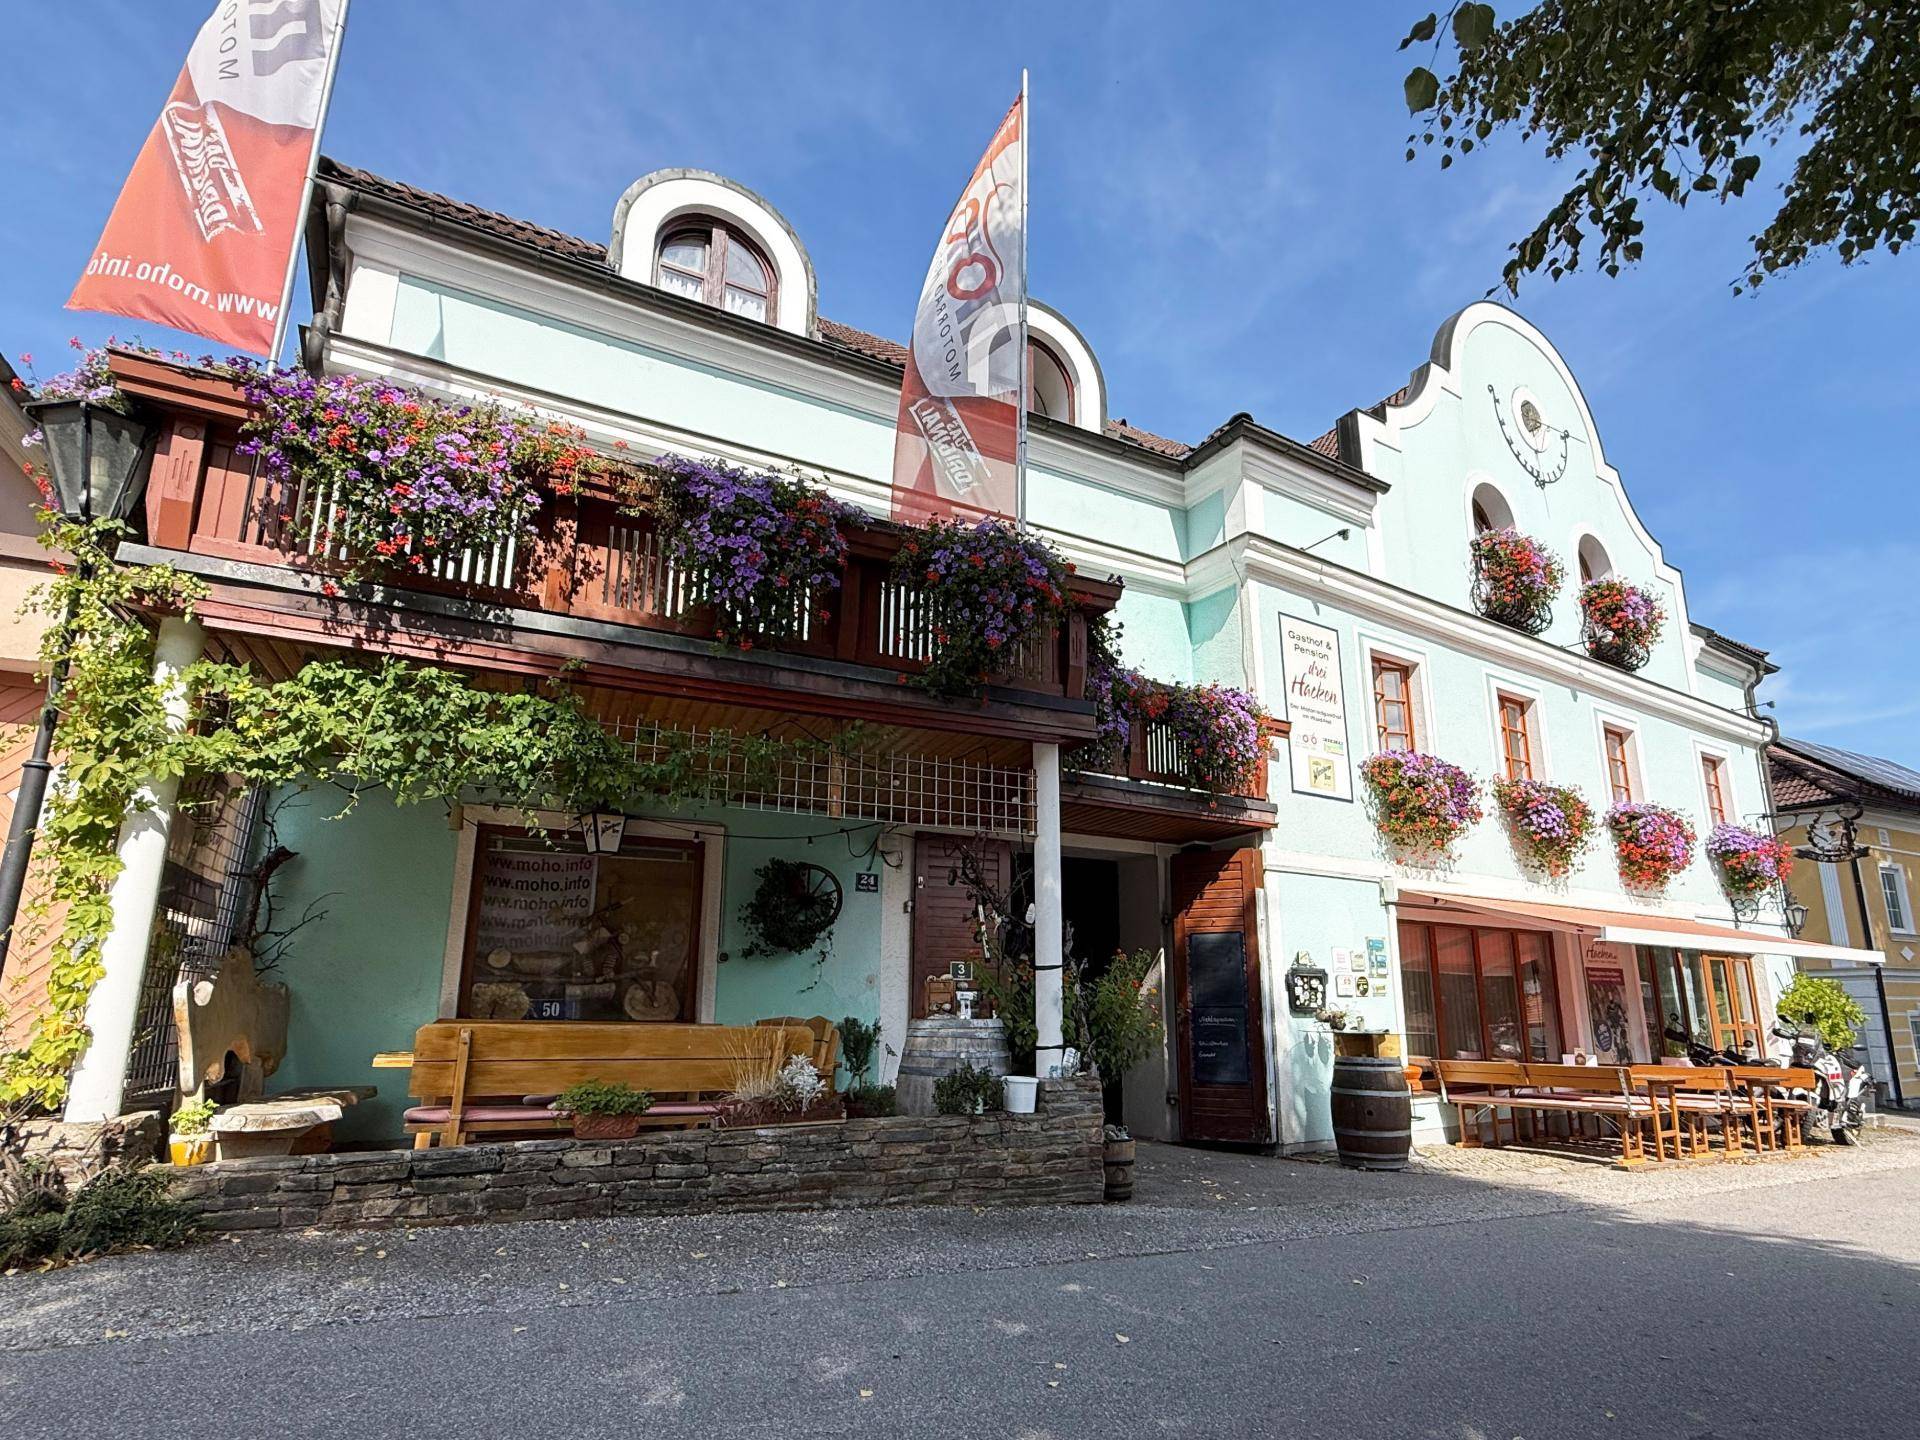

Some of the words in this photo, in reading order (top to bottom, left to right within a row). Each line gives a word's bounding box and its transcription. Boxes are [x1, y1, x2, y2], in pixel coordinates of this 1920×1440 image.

[1288, 630, 1323, 648] Gasthof
[1325, 641, 1332, 651] &
[1294, 643, 1329, 661] Pension
[1291, 672, 1337, 704] Hacken
[482, 875, 591, 892] ww.moho.info
[860, 874, 874, 885] 24
[956, 964, 965, 974] 3
[542, 1001, 560, 1017] 50
